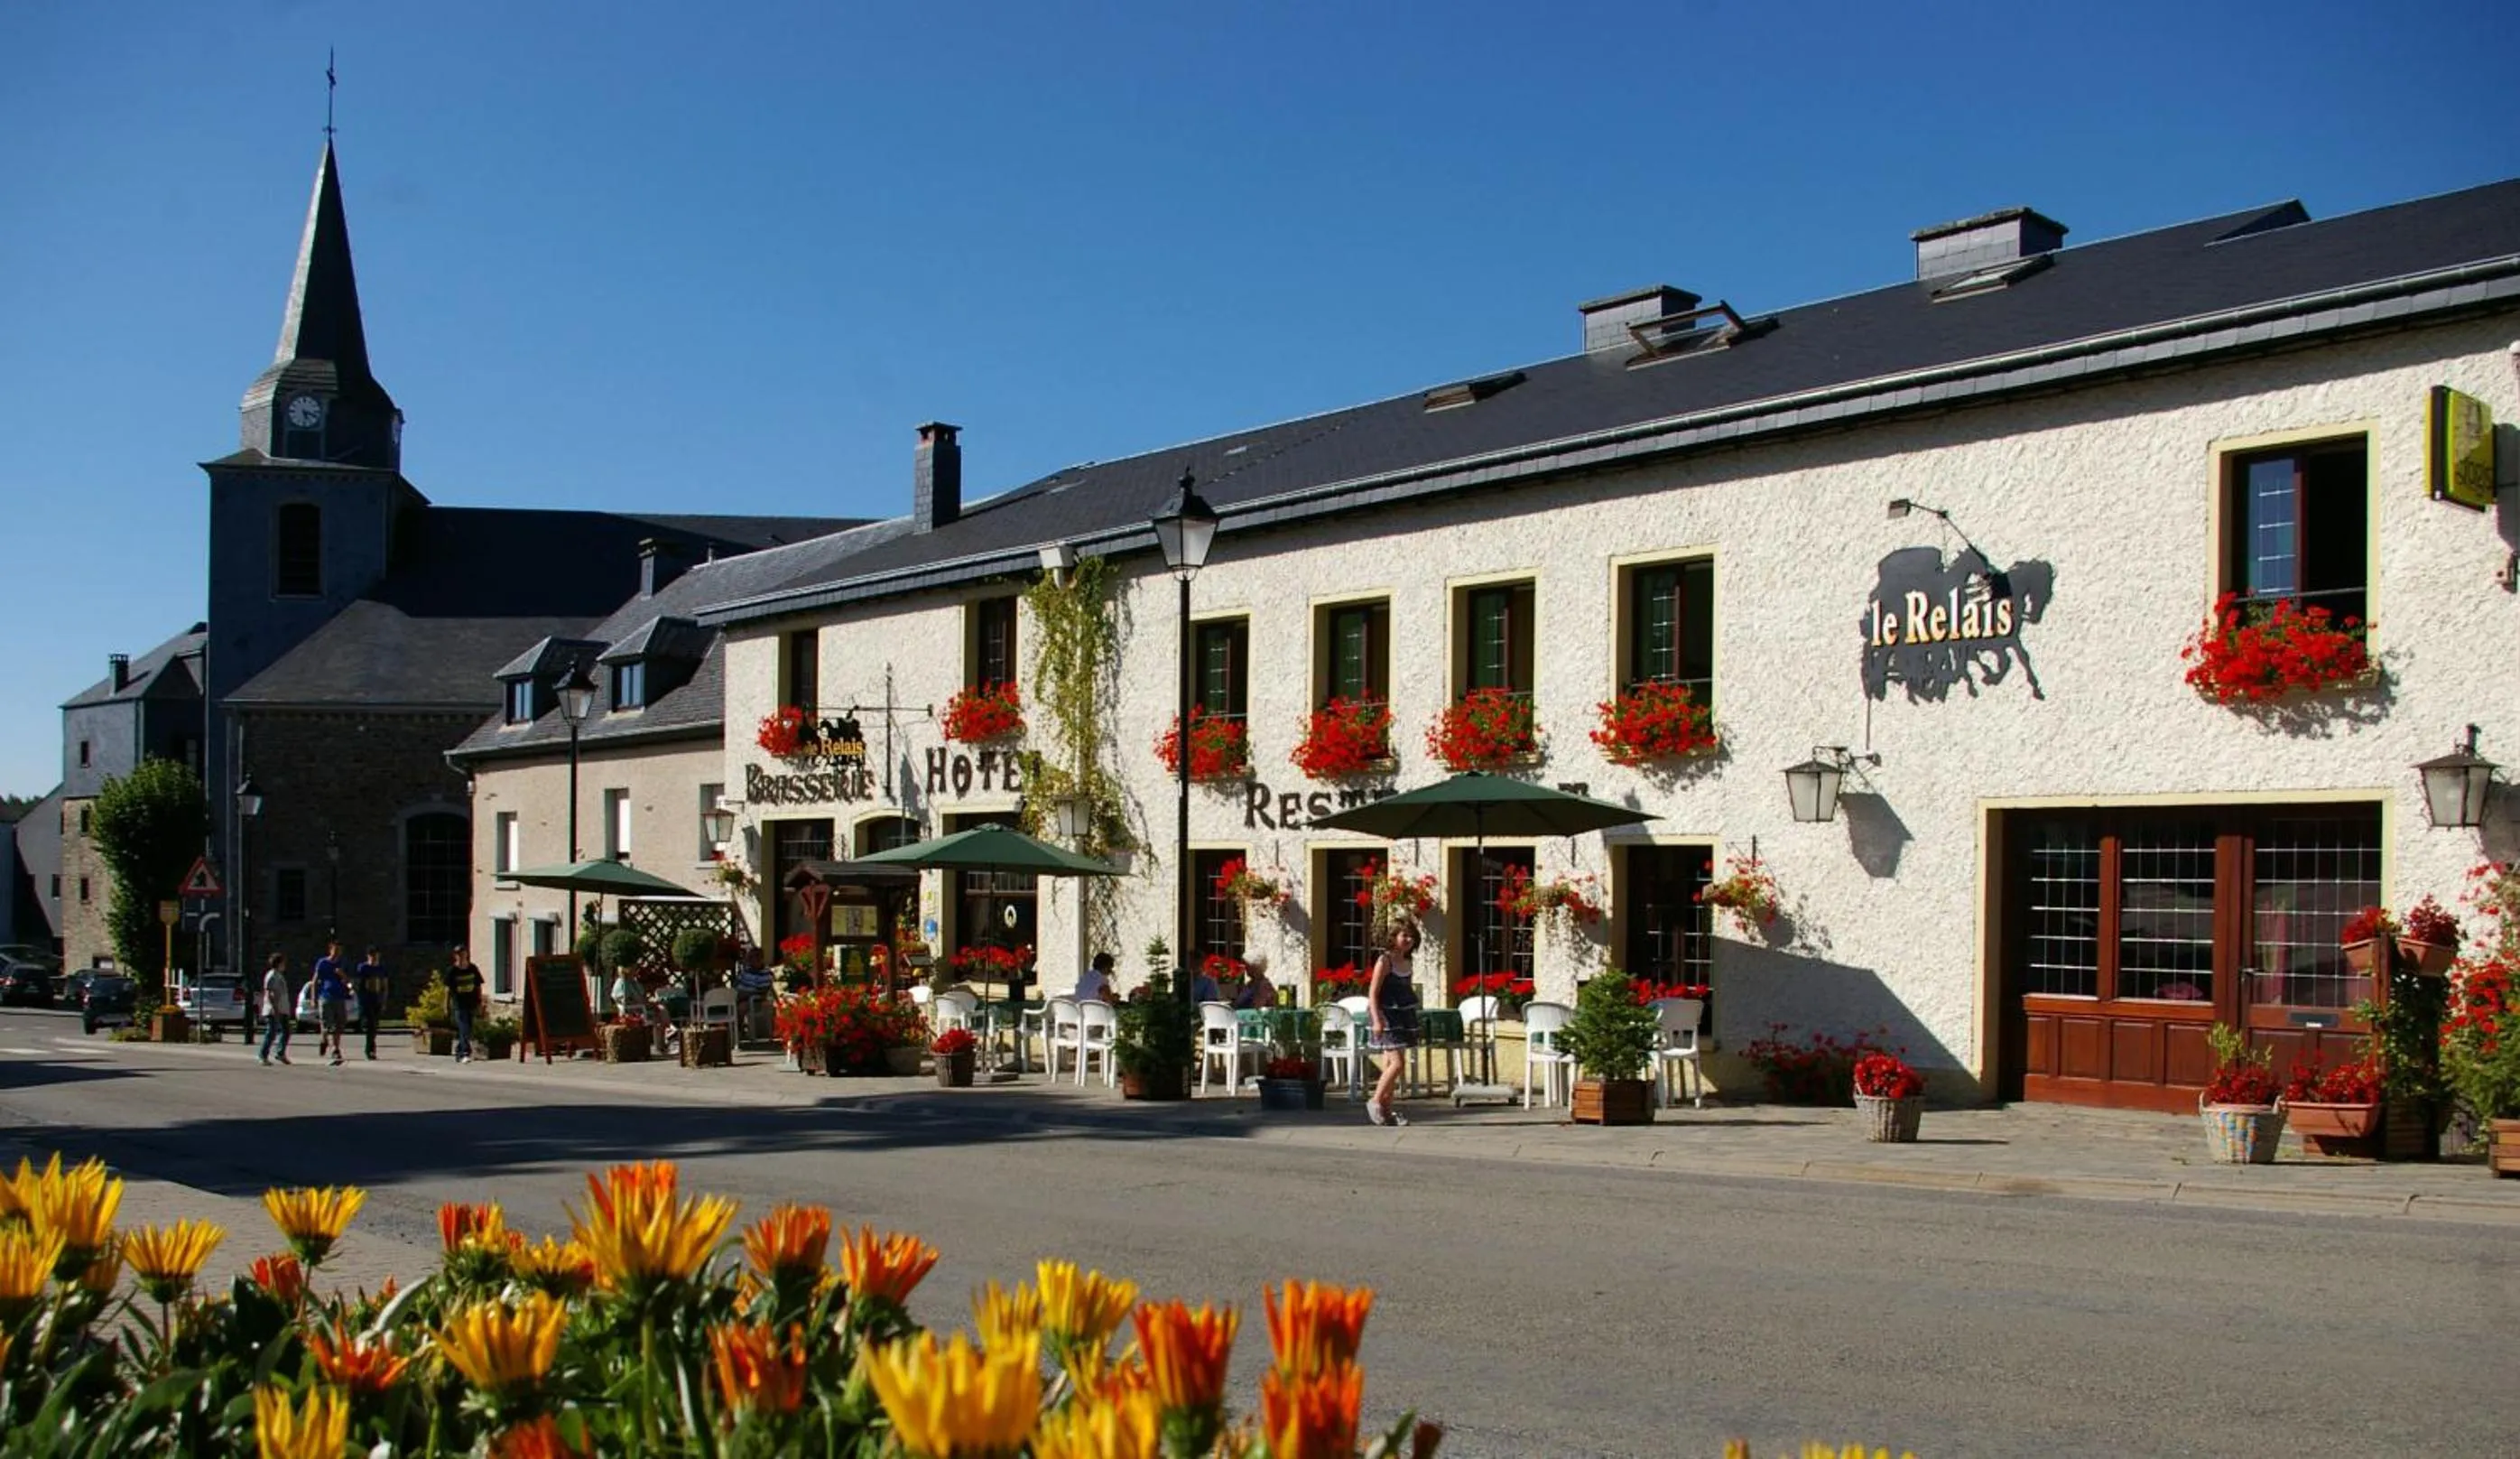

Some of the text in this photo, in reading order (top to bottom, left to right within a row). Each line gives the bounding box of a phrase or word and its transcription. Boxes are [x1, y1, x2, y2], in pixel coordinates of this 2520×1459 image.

[1870, 586, 2014, 646] le Relais
[820, 736, 865, 756] Relais
[746, 763, 876, 805] BRASSERIE
